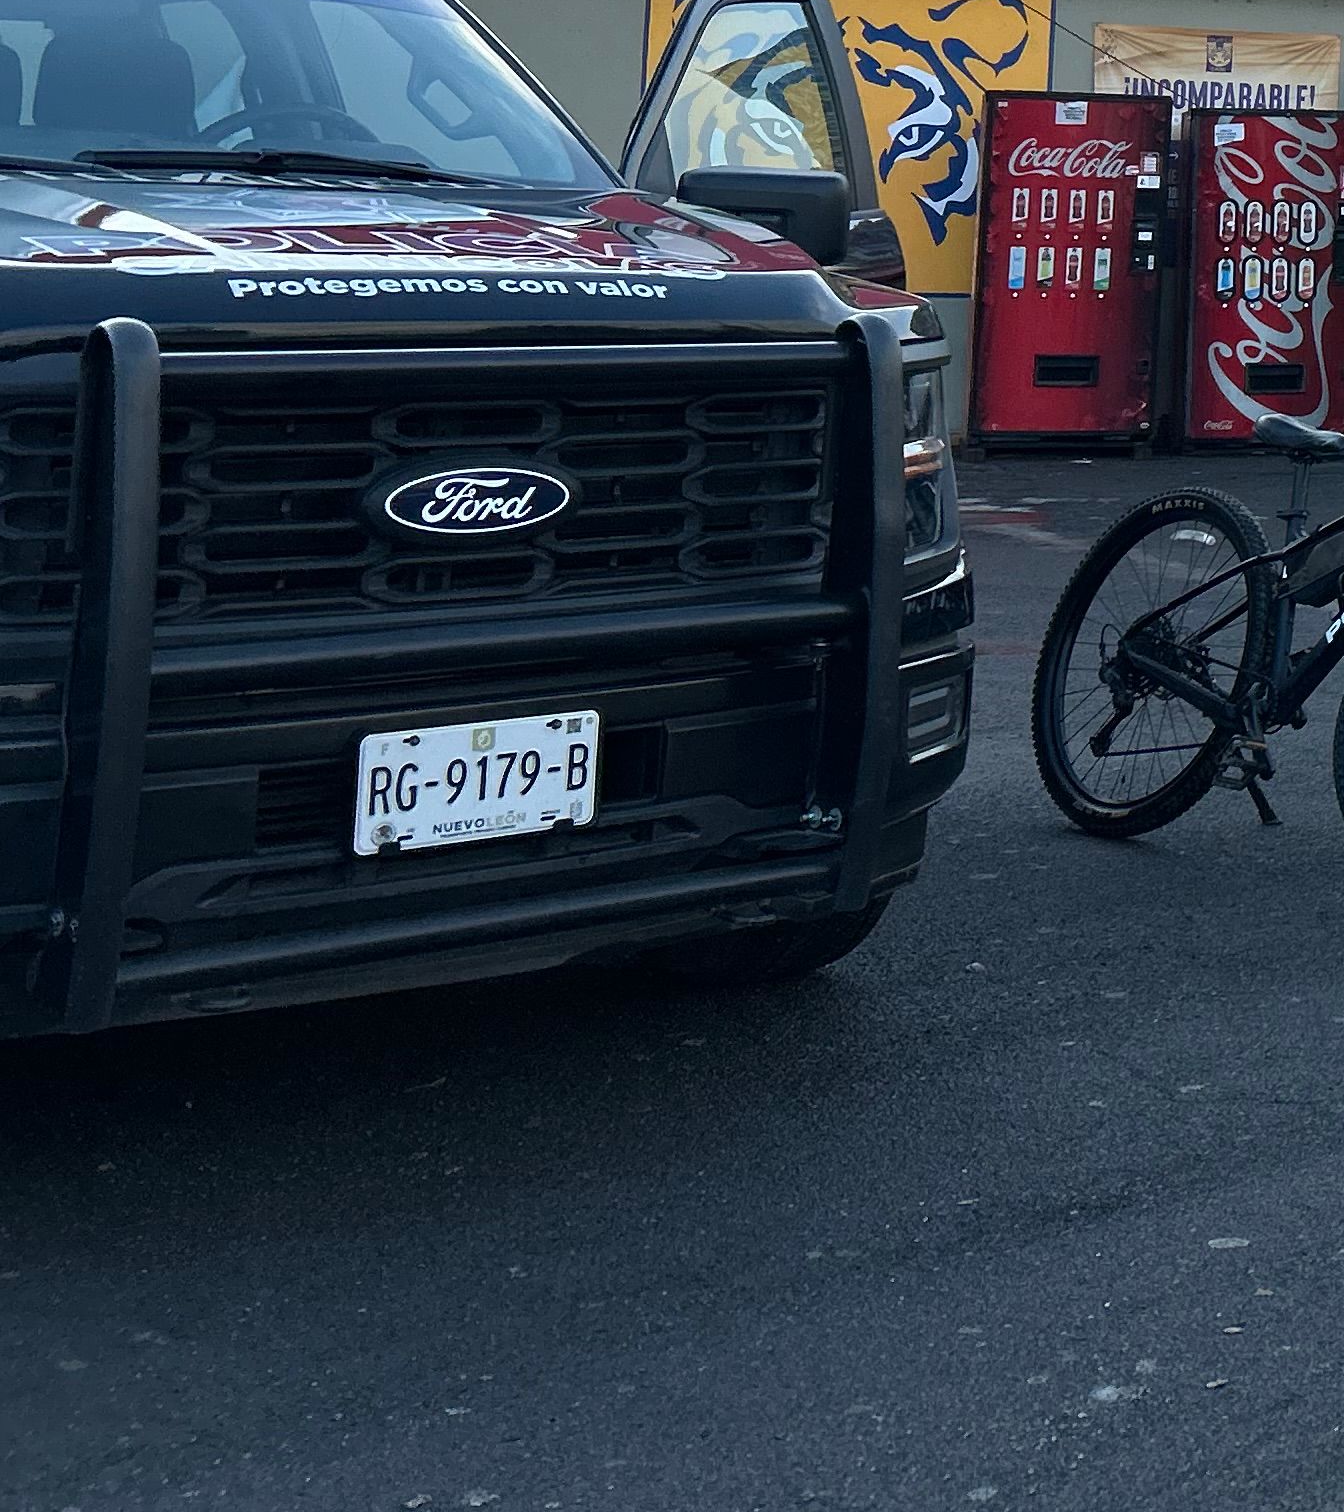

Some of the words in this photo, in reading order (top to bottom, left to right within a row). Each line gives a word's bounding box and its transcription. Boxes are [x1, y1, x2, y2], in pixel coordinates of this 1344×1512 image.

[1008, 137, 1133, 179] Coca-Cola
[228, 277, 488, 299] Protegemos
[497, 276, 569, 295] con
[577, 278, 668, 300] valor
[421, 477, 537, 524] Ford
[1151, 498, 1205, 516] MAXXIS
[368, 743, 590, 816] RG-9179-B
